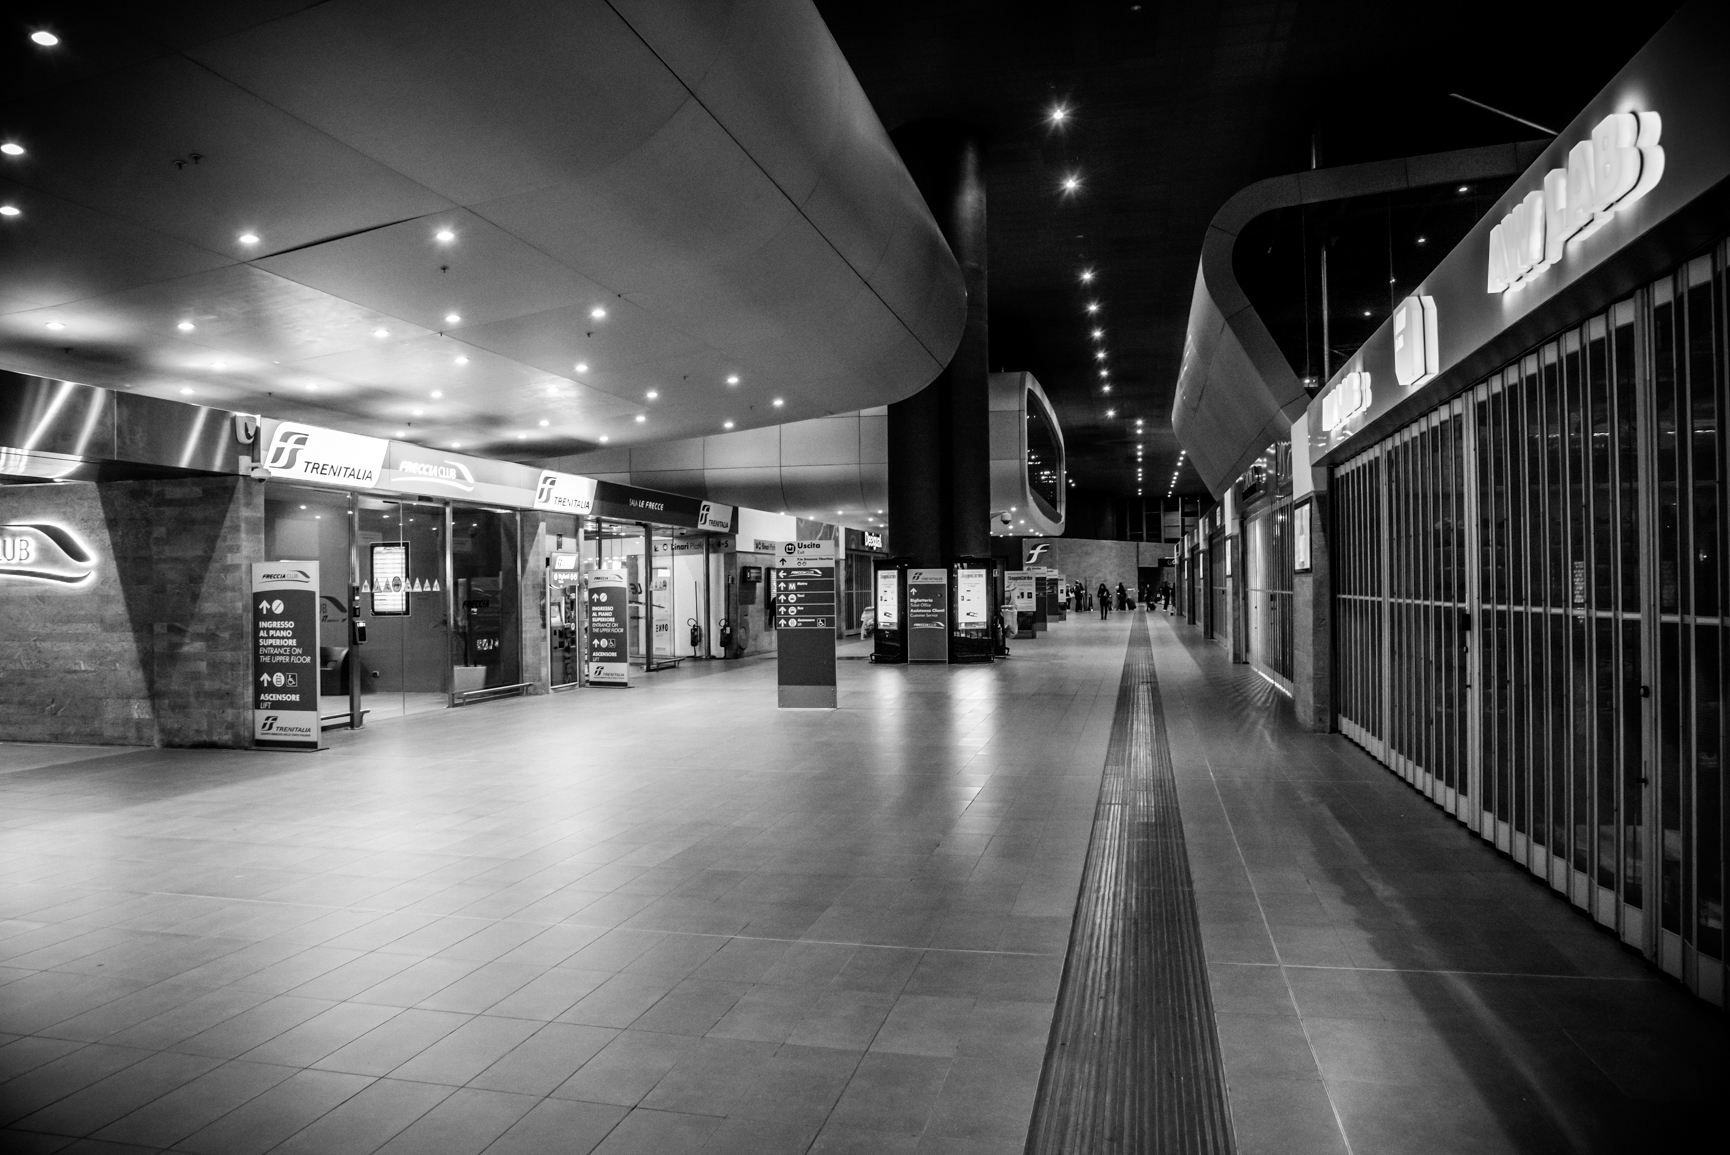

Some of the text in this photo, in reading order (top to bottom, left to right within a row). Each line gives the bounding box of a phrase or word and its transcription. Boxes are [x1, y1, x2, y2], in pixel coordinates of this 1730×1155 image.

[303, 460, 373, 481] TRENITALIA
[554, 496, 590, 510] TRENITALIA
[708, 519, 729, 528] TRENITALIA
[717, 540, 729, 548] 4-5
[789, 582, 796, 590] M
[272, 655, 290, 663] UPPER
[290, 655, 311, 663] FLOOR
[260, 693, 300, 701] ASCENSORE
[260, 701, 272, 709] LIFT
